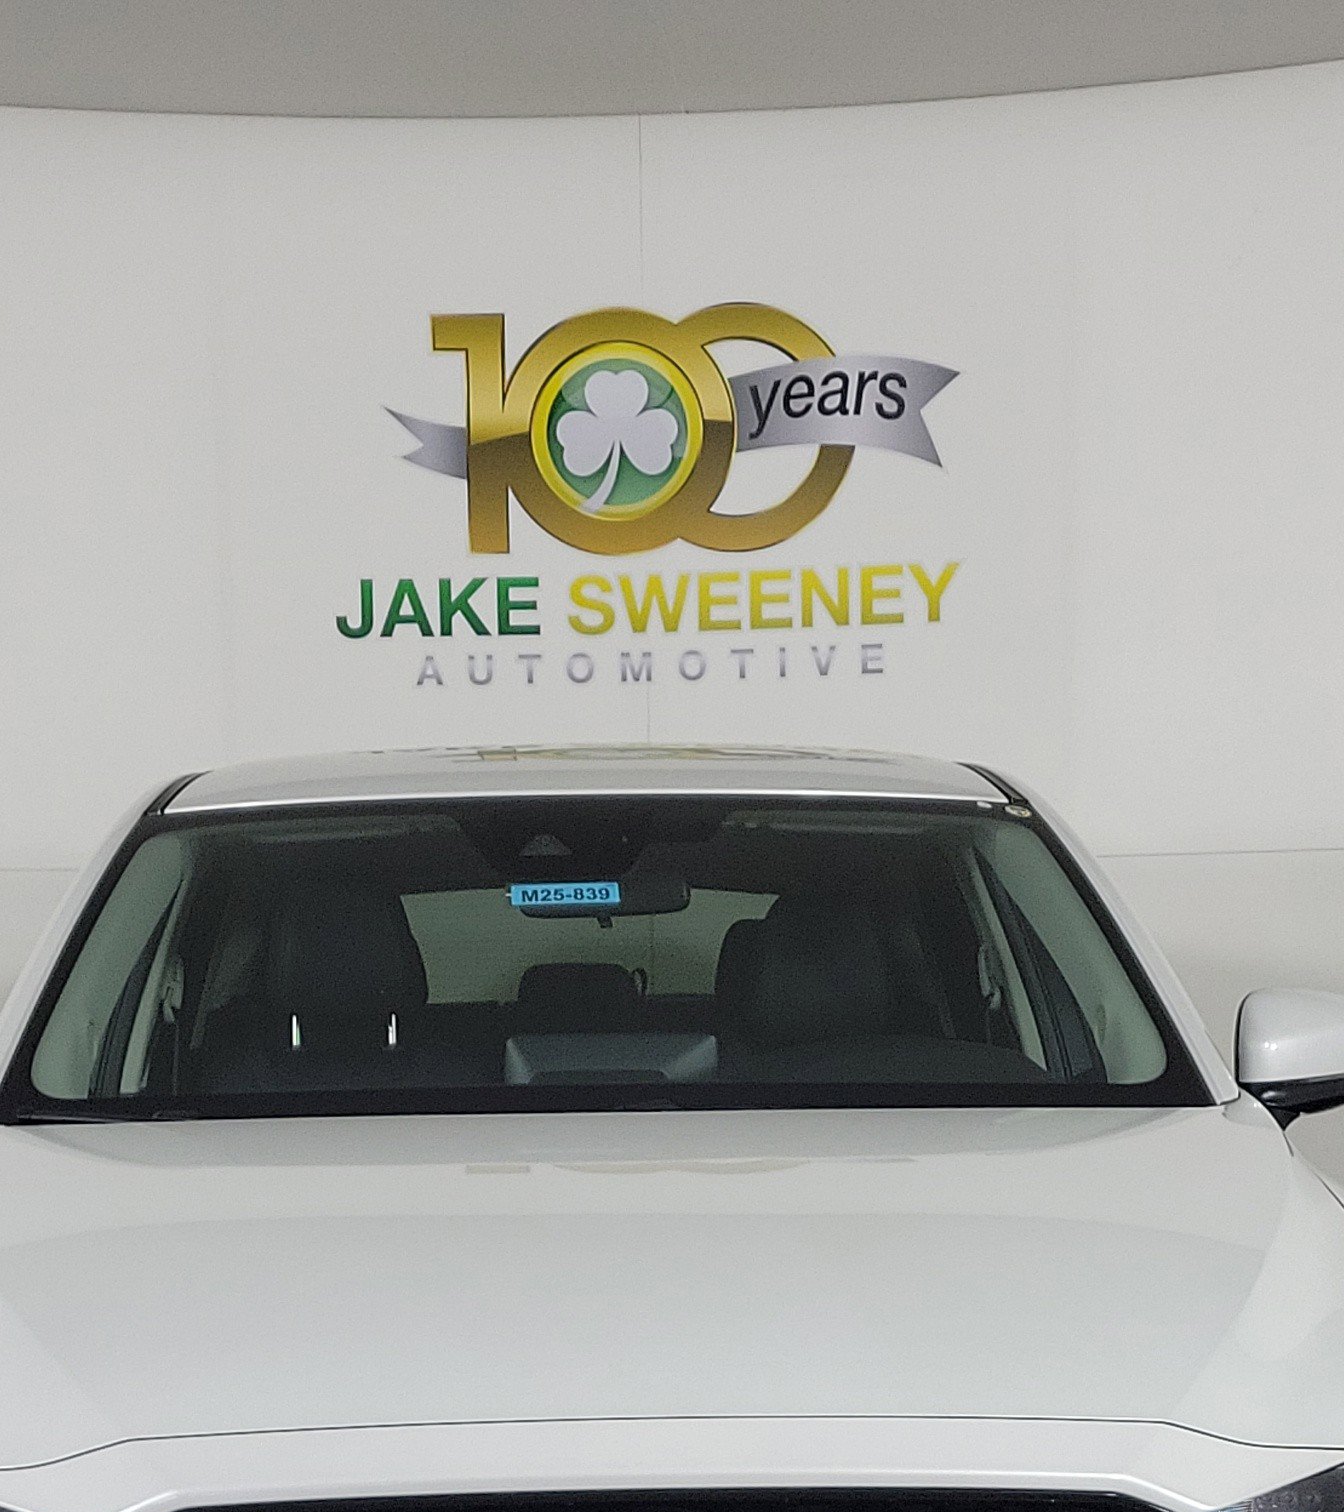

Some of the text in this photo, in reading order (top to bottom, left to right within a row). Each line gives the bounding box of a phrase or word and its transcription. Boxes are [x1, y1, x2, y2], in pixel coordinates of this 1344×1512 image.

[748, 368, 907, 440] years
[335, 562, 959, 638] JAKE SWEENEY
[416, 643, 885, 687] AUTOMOTIVE
[520, 888, 611, 903] M25-839
